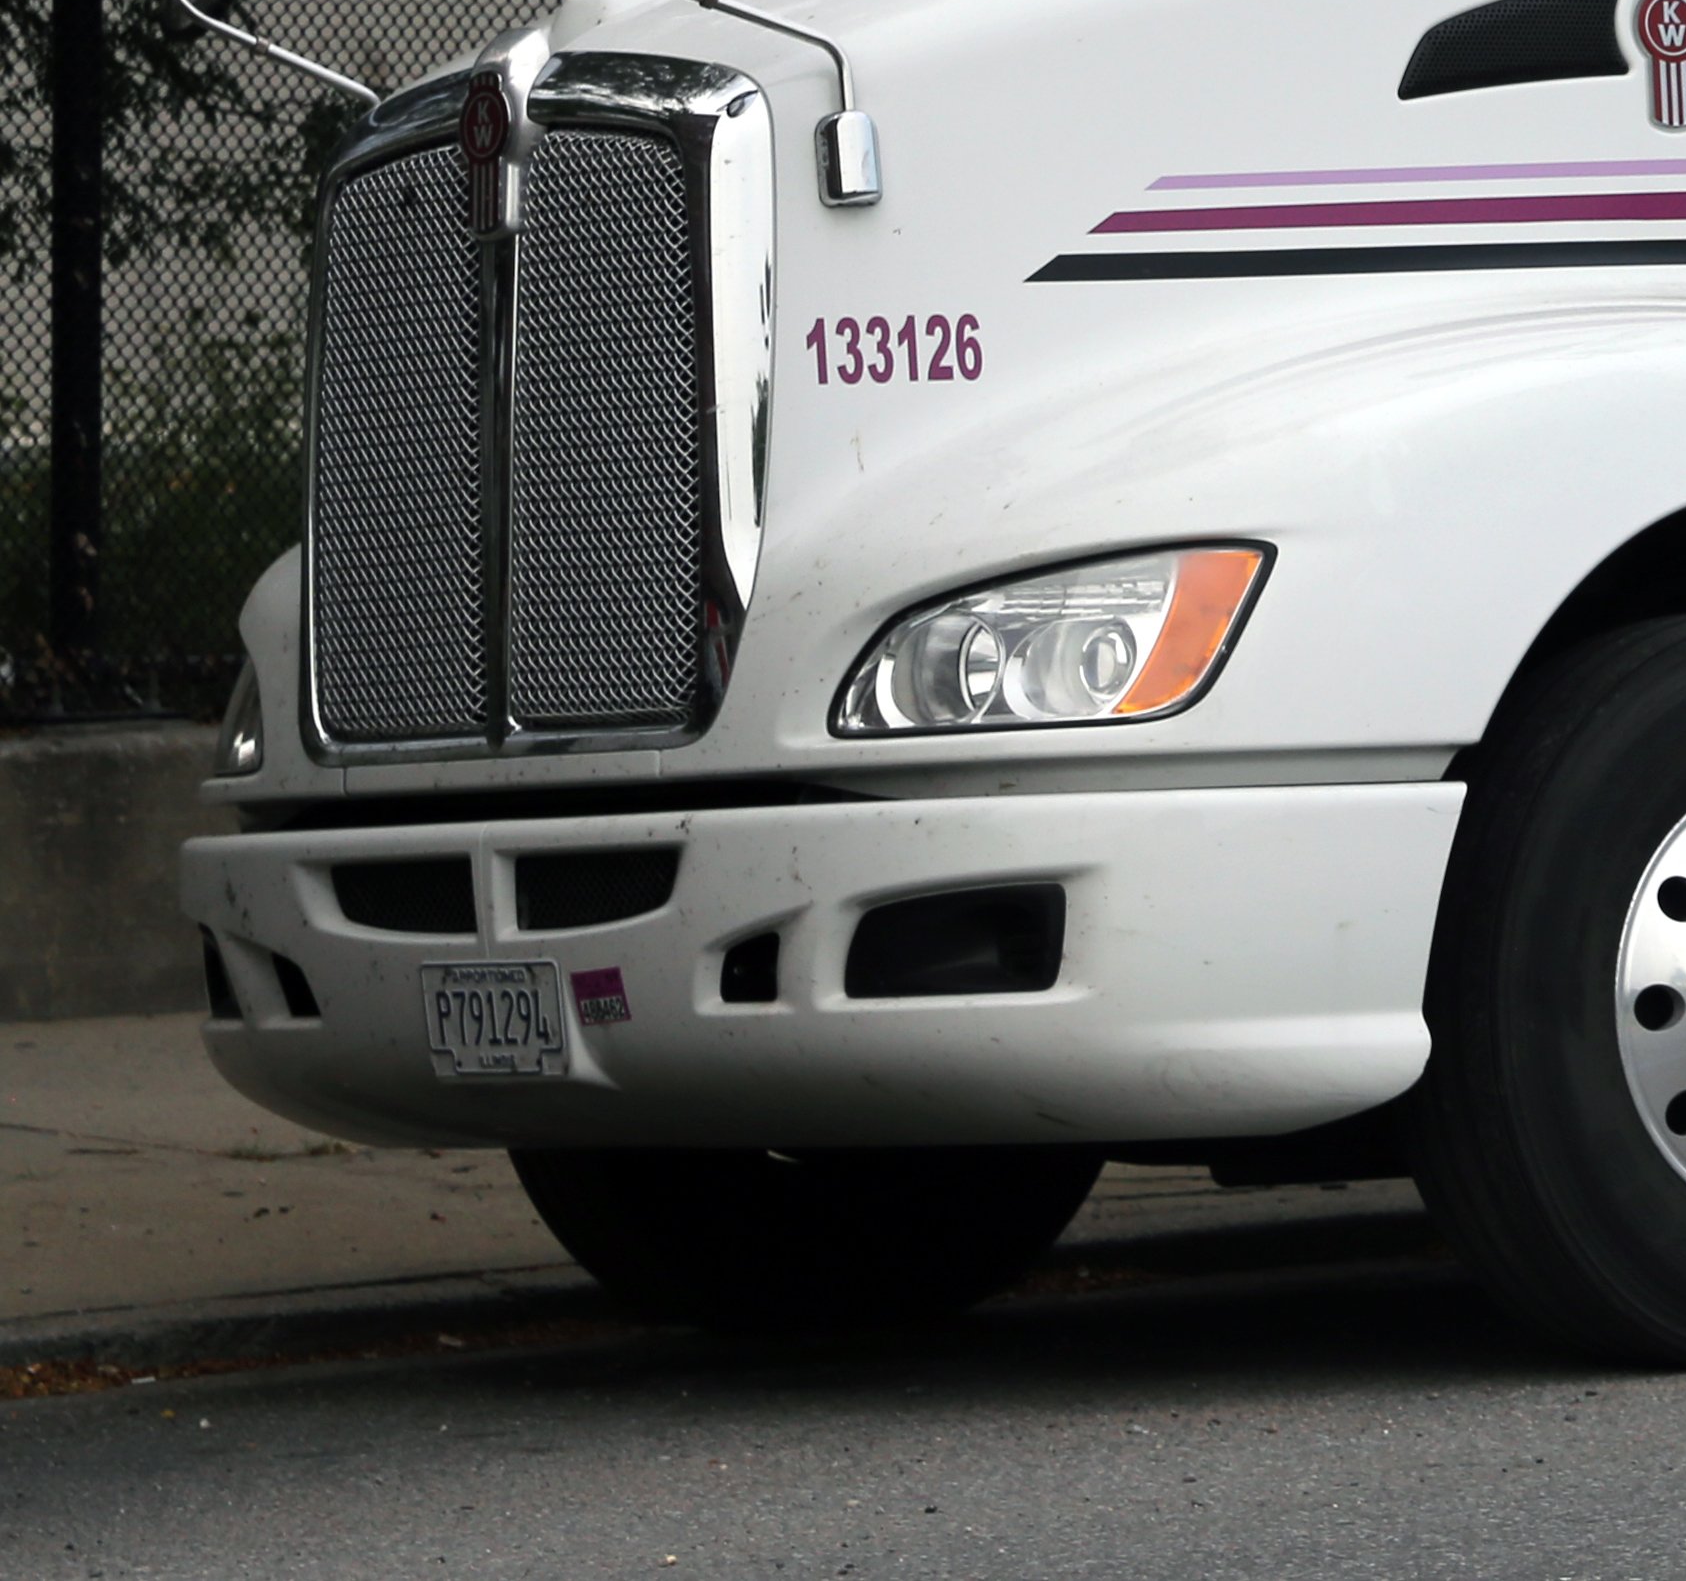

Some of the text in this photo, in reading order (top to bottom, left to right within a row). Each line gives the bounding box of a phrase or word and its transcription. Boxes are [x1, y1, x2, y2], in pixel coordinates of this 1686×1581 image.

[805, 313, 983, 385] 133126
[451, 968, 526, 984] APPORTIONED
[436, 989, 549, 1045] P791294
